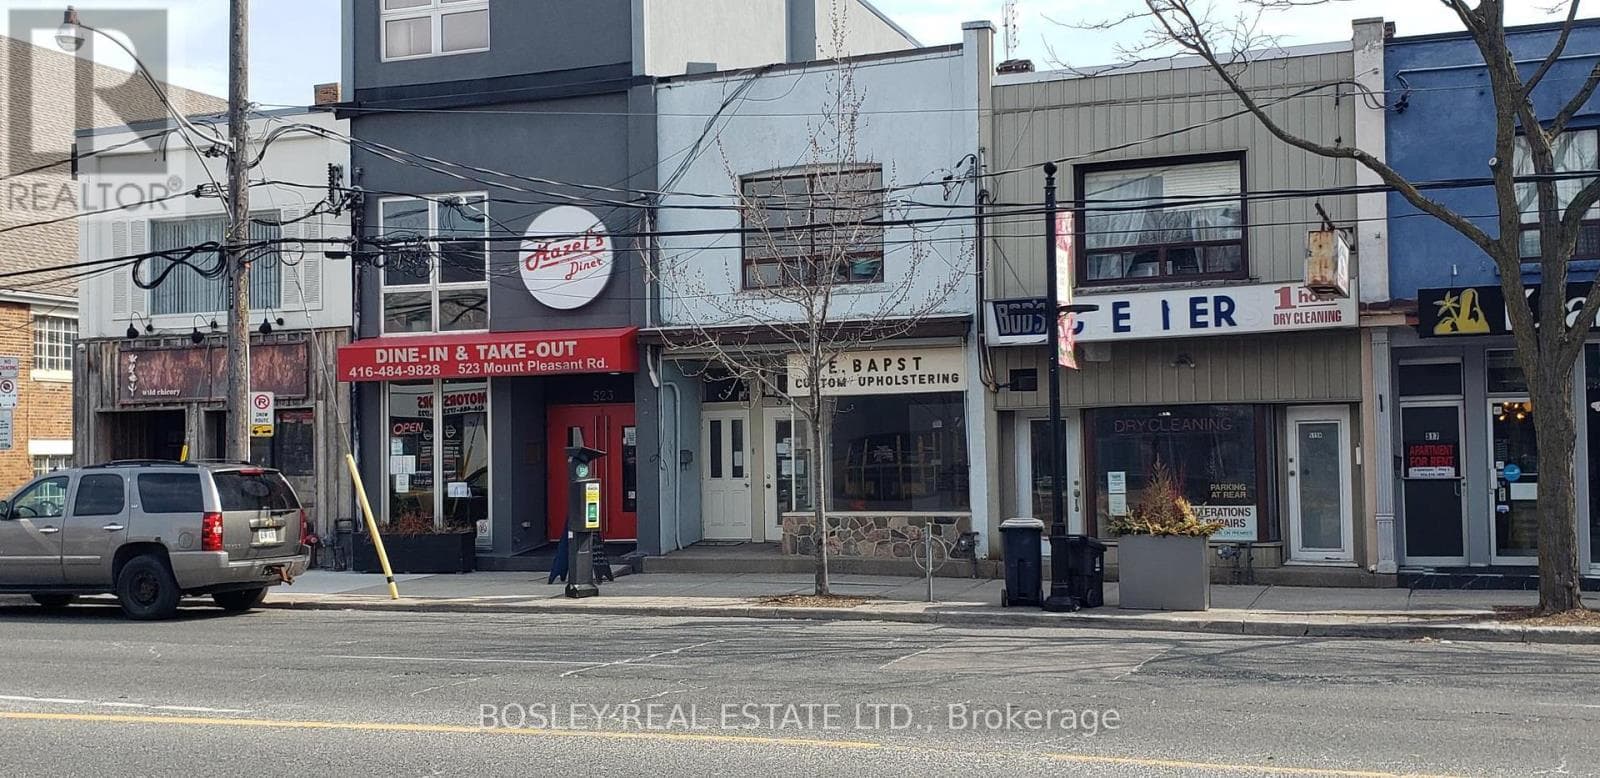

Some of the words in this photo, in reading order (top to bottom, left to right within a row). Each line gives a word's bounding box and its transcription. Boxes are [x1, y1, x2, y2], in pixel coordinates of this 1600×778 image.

[565, 258, 604, 281] Diner
[1274, 286, 1297, 310] 1
[1298, 290, 1335, 303] ho
[1273, 312, 1292, 325] DRY
[1294, 310, 1342, 324] CLEANING
[375, 346, 449, 364] DINE-IN
[455, 345, 468, 361] &
[476, 341, 577, 360] TAKE-OUT
[349, 364, 441, 377] 416-484-9828
[458, 363, 480, 374] 523
[484, 361, 524, 373] Mount
[527, 359, 582, 371] Pleasant
[587, 358, 609, 369] Rd.
[828, 361, 846, 374] E.
[853, 357, 922, 373] BAPST
[795, 377, 847, 389] CUTOM
[858, 373, 960, 387] UPHOLSTERING
[156, 389, 181, 397] chicory
[593, 390, 614, 401] 523
[393, 422, 424, 435] OPEN
[1409, 444, 1454, 456] APARTMENT
[1409, 456, 1428, 467] FOR
[1430, 456, 1454, 467] RENT
[1210, 483, 1247, 491] PARKING
